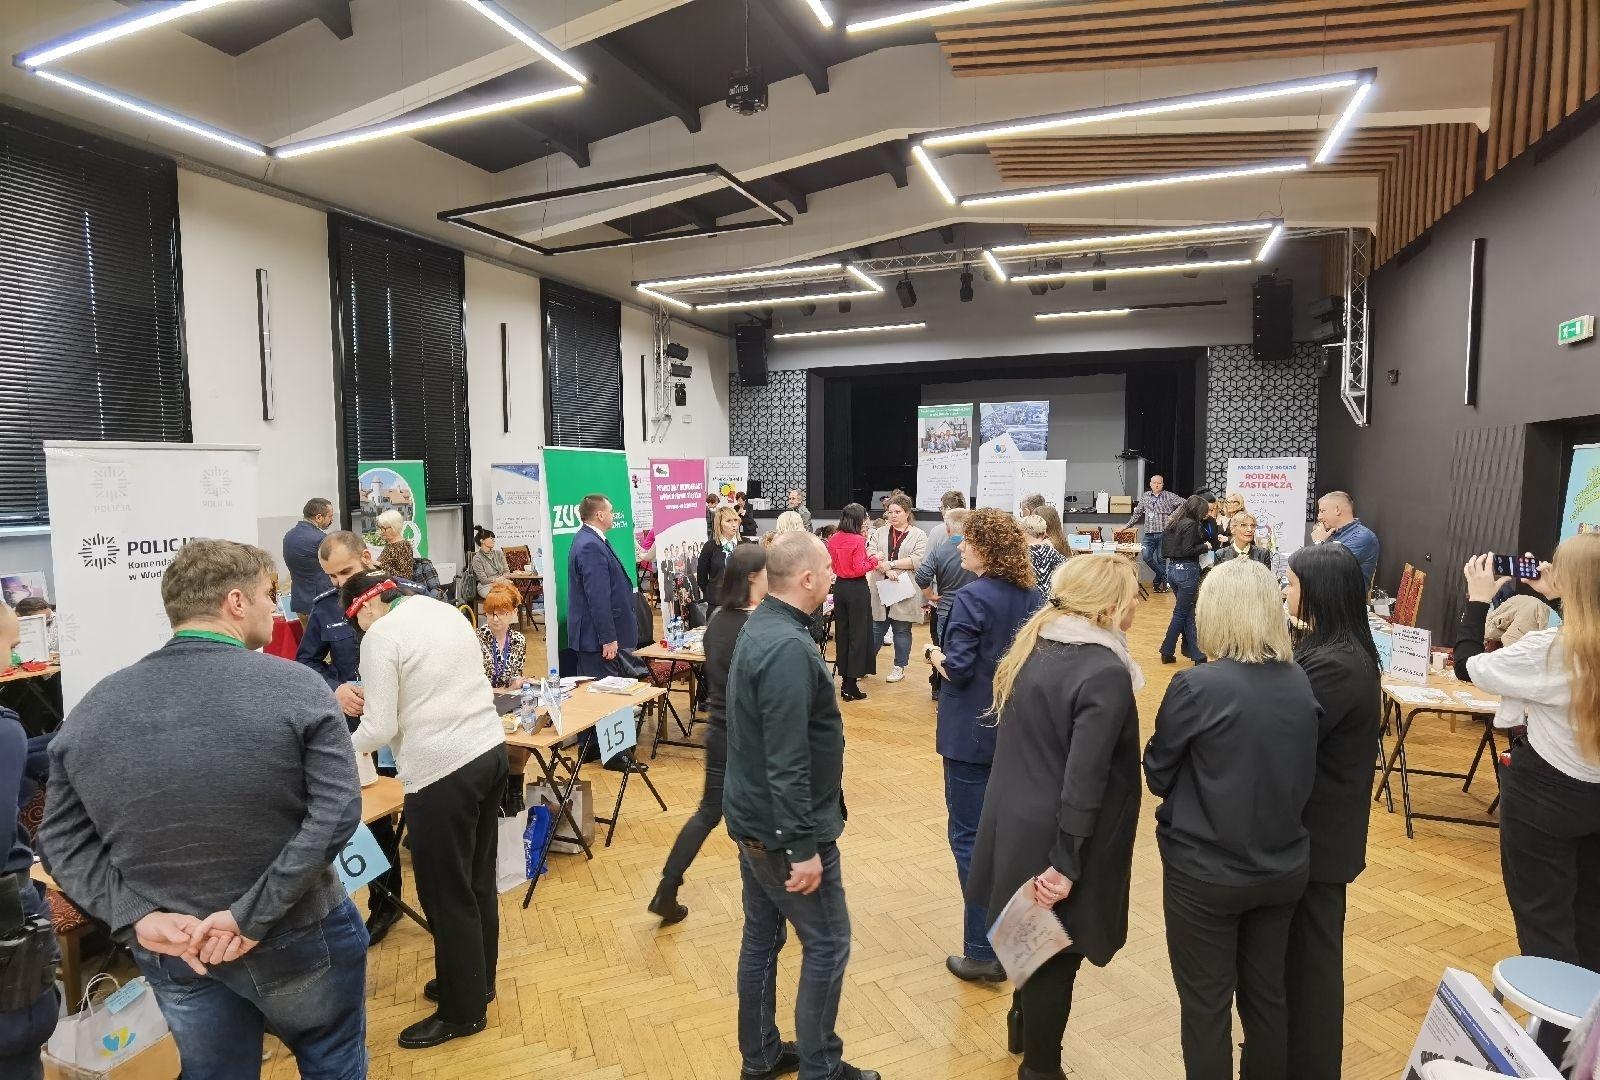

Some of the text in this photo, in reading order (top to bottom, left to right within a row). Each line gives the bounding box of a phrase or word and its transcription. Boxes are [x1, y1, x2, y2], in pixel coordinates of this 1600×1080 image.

[1245, 473, 1287, 481] RODZINĄ
[1239, 481, 1294, 491] ZASTĘPCZĄ
[603, 720, 625, 753] 15
